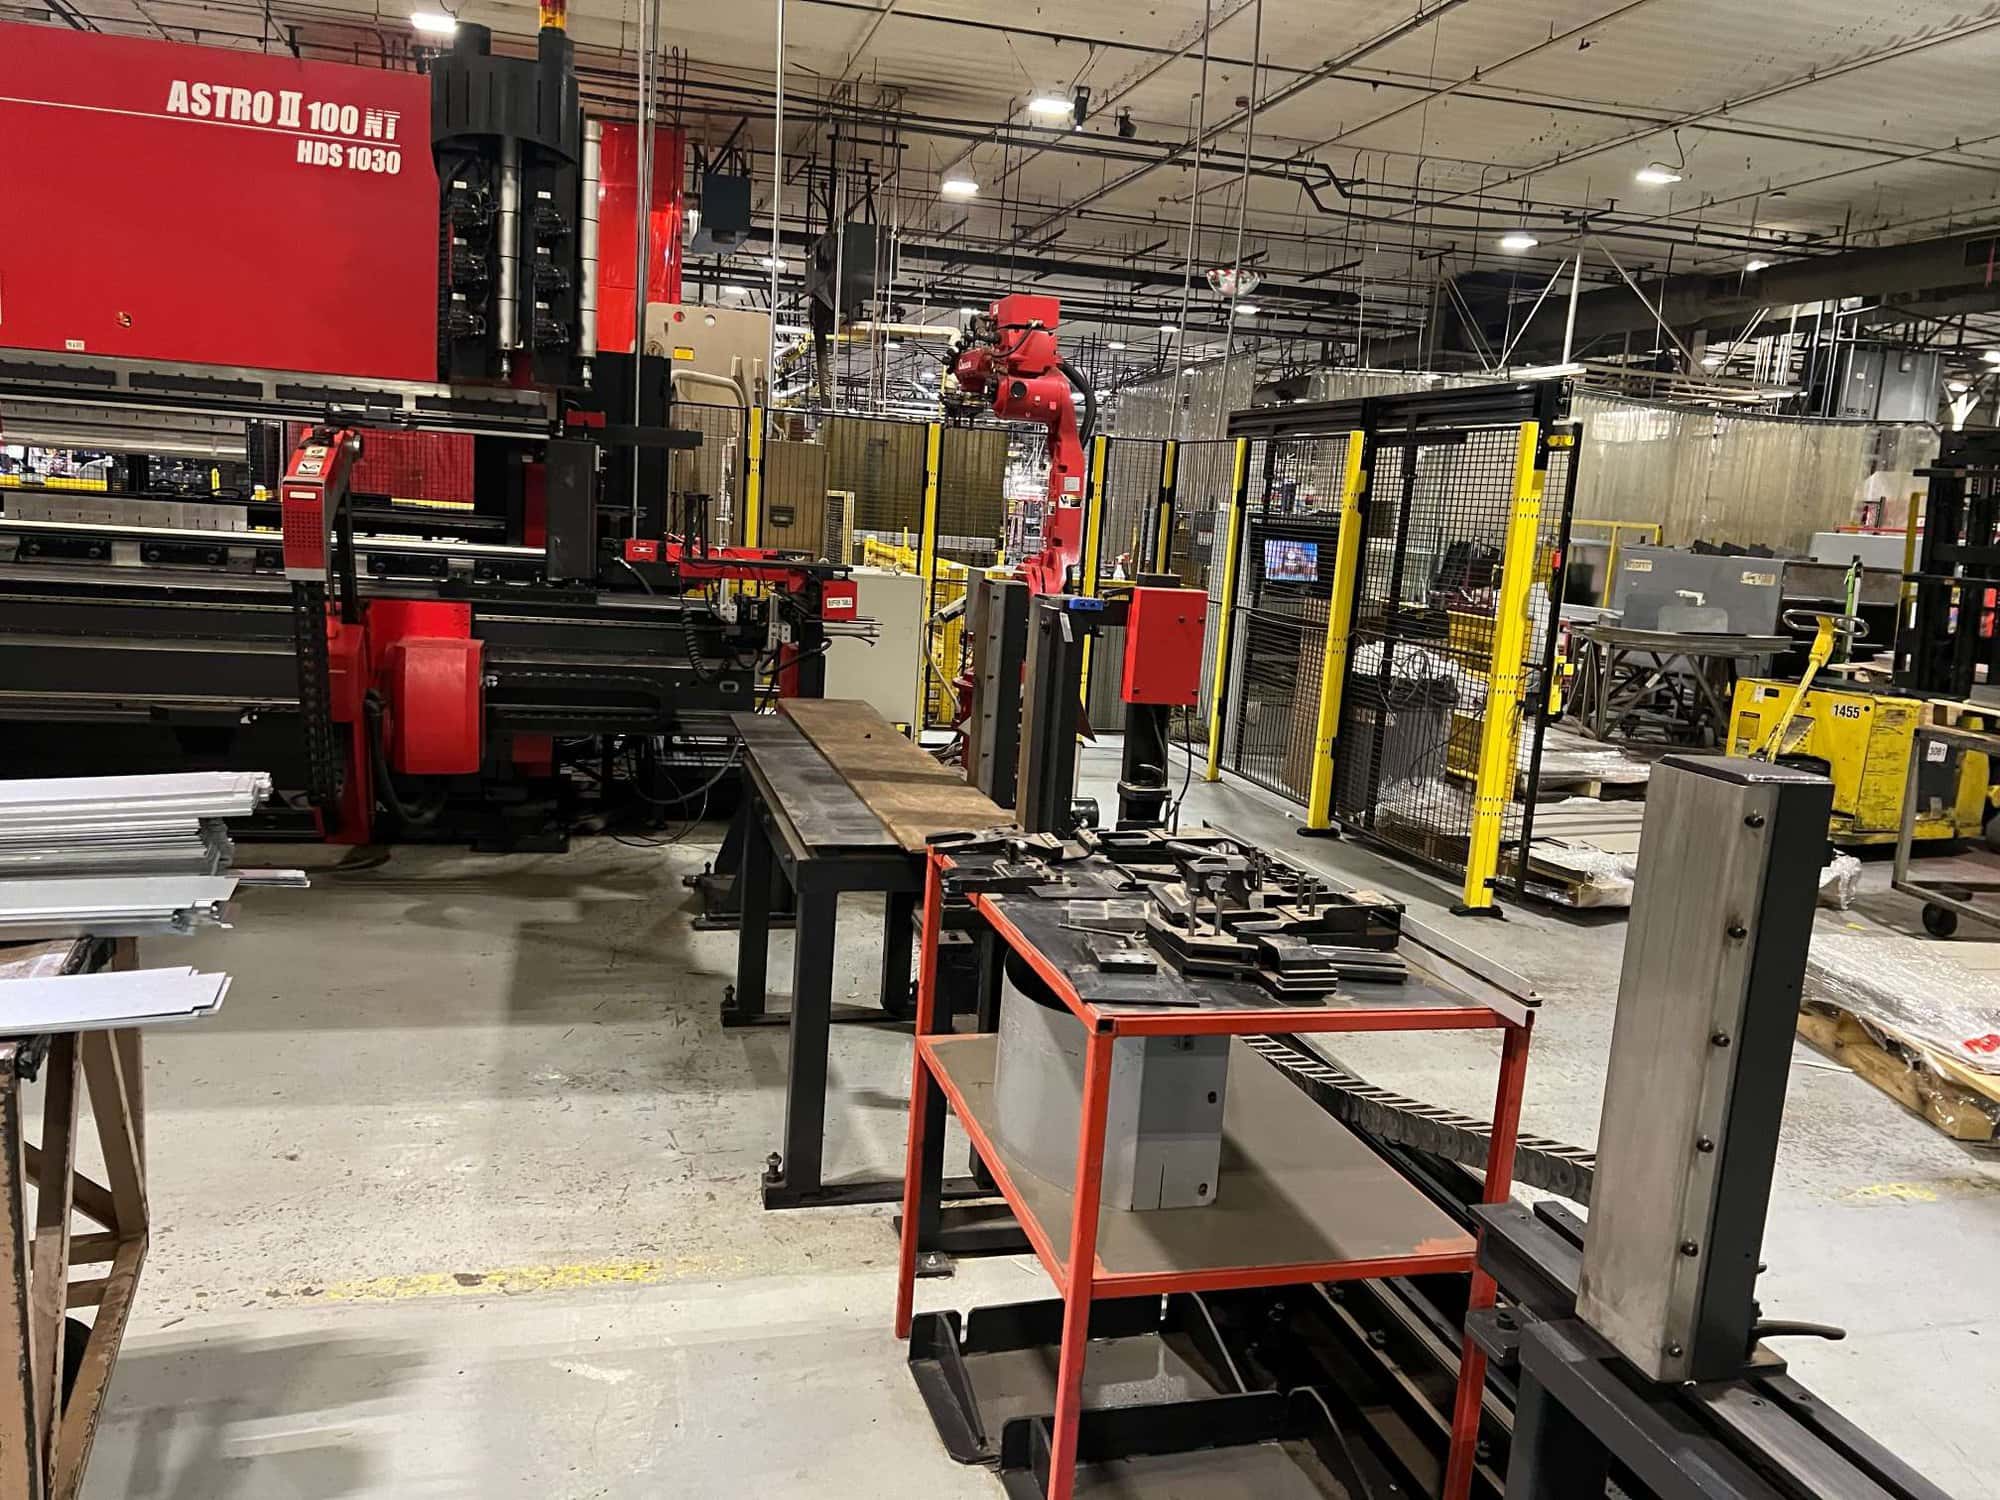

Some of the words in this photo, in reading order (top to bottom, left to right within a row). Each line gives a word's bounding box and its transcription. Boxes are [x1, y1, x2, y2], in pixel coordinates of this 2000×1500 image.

[166, 80, 274, 124] ASTRO
[307, 101, 359, 135] 100
[364, 107, 400, 140] NT
[296, 140, 343, 168] HDS
[347, 146, 401, 174] 1030
[1833, 704, 1860, 719] 1455
